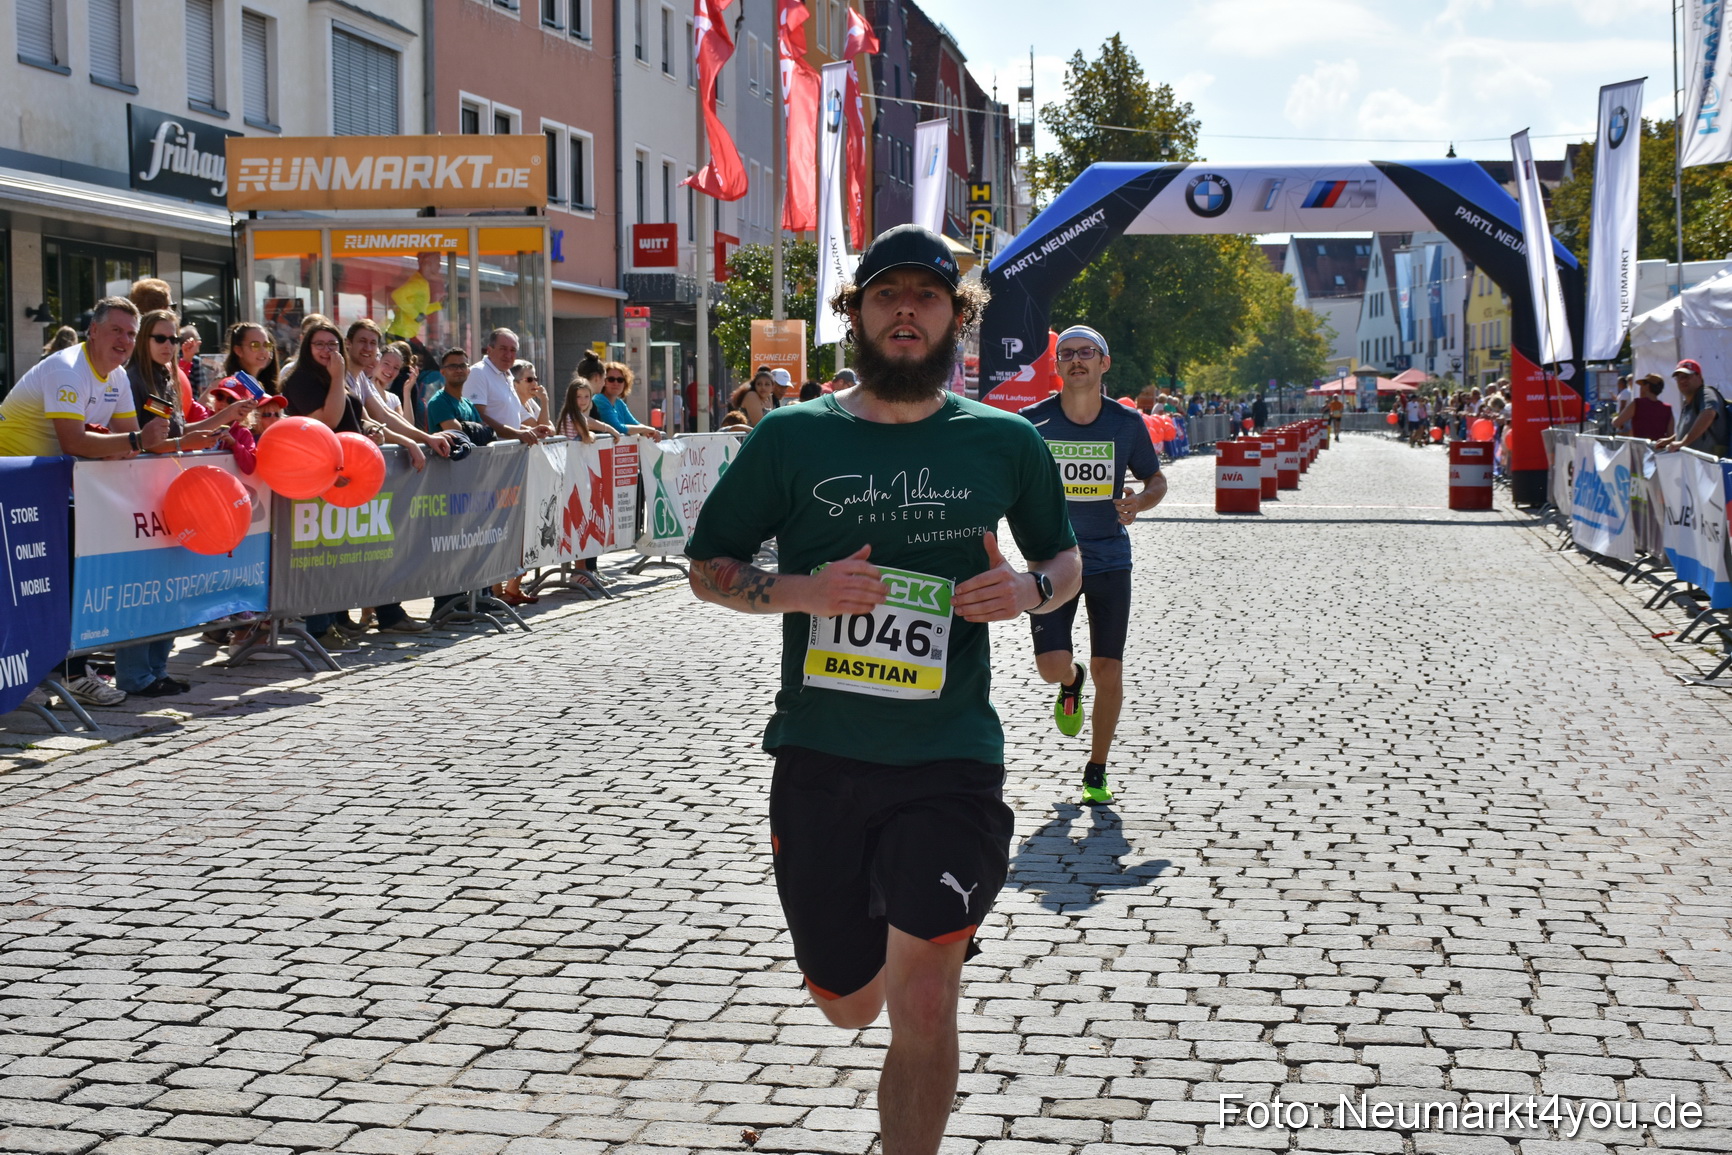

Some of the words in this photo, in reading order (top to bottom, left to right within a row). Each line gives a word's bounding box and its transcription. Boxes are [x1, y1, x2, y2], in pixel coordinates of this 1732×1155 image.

[238, 155, 530, 192] RUNMARKT.DE
[1454, 206, 1493, 236] PARTL
[344, 234, 458, 249] RUNMARKT.DE
[639, 238, 668, 249] WITT
[1003, 249, 1043, 280] PARTL
[1040, 208, 1107, 257] NEUMARKT
[1620, 248, 1629, 313] NEUMARKT
[59, 389, 77, 405] 20
[1050, 443, 1108, 457] BOCK
[409, 494, 447, 519] OFFICE
[813, 474, 892, 517] Sandra
[11, 507, 39, 524] STORE
[293, 498, 393, 542] BOCK
[858, 510, 946, 524] FRISEURE
[16, 542, 47, 560] ONLINE
[290, 553, 325, 571] inspired
[327, 553, 338, 567] by
[339, 551, 362, 564] smart
[21, 577, 51, 596] MOBILE
[82, 588, 113, 614] AUF
[116, 582, 160, 612] JEDER
[165, 572, 217, 602] STRECKE
[216, 562, 265, 591] ZUHAUSE
[80, 629, 110, 641] railone.de
[829, 611, 933, 657] 1046
[825, 657, 917, 684] BASTIAN
